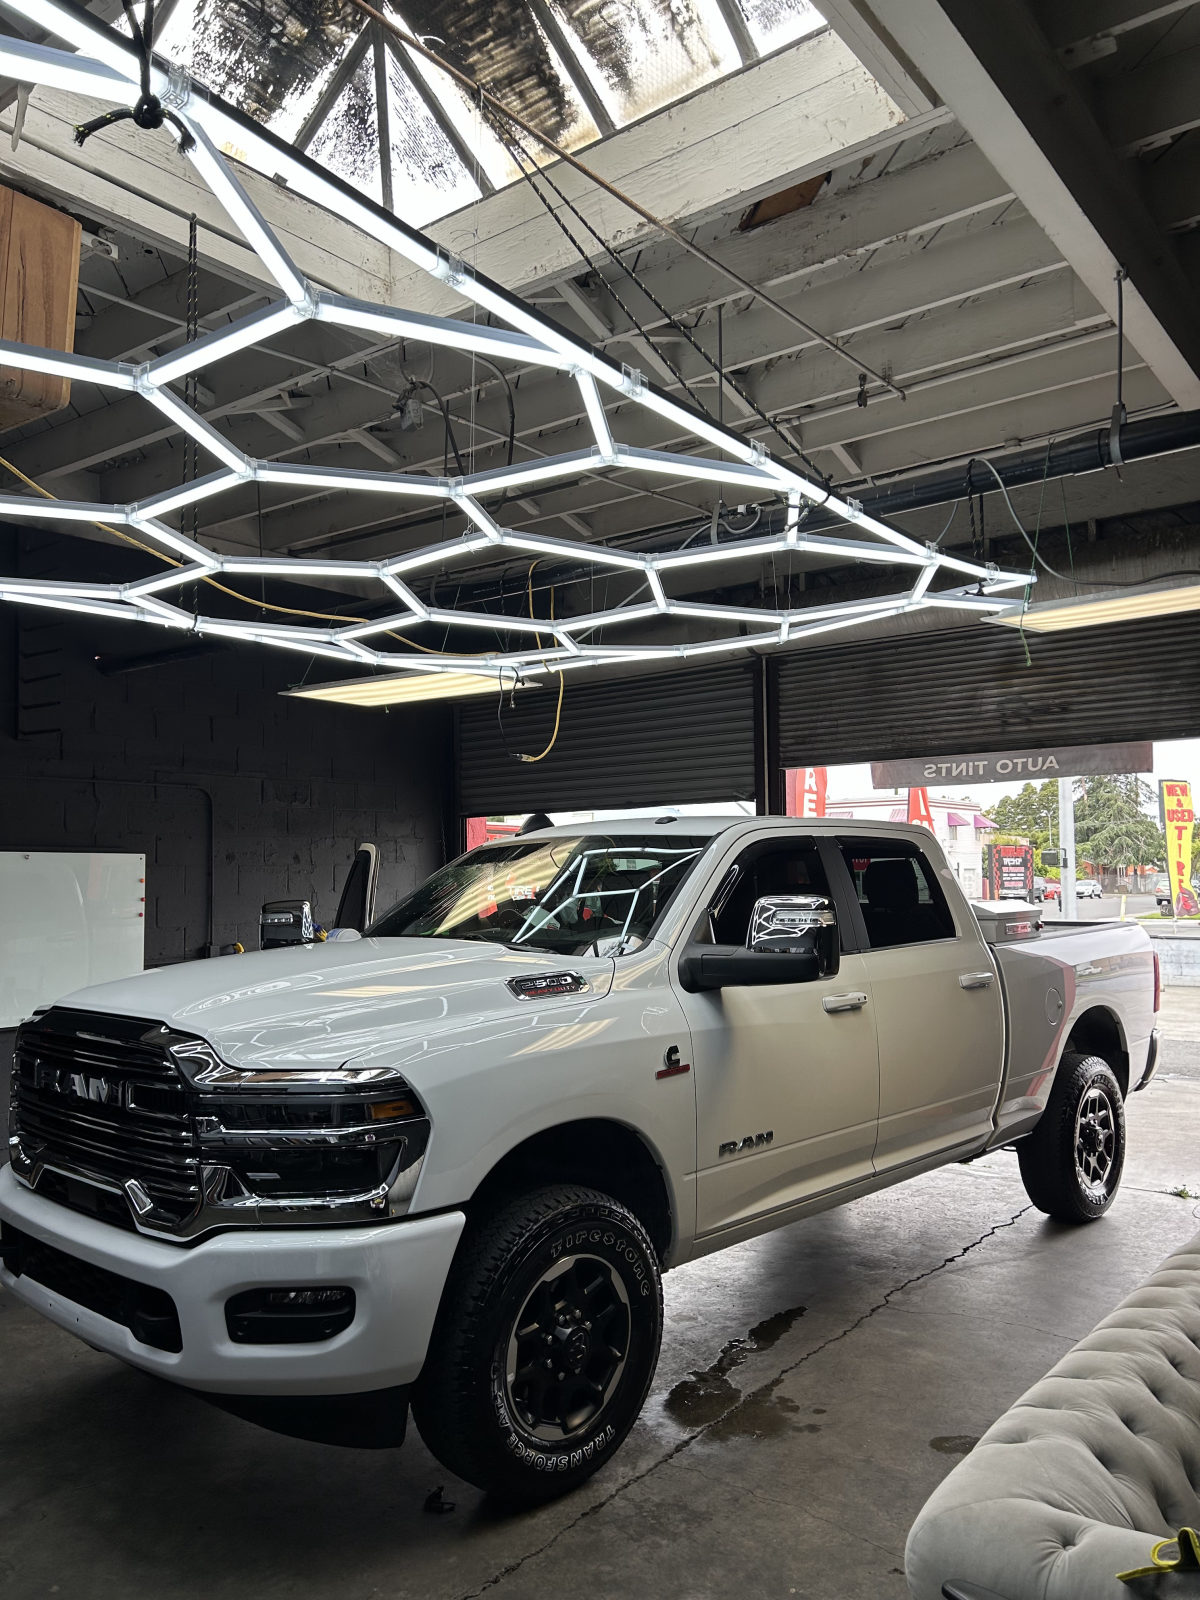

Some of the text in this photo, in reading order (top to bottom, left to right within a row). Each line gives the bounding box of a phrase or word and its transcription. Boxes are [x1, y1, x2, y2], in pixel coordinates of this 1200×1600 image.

[1165, 783, 1188, 797] NEW
[1176, 797, 1184, 808] &
[1166, 808, 1194, 823] USED
[521, 976, 573, 990] 2500
[525, 985, 577, 996] HEAVY DUTY
[719, 1130, 774, 1157] RAM
[551, 1230, 650, 1296] Firestone
[507, 1424, 616, 1472] TRANSFORCE
